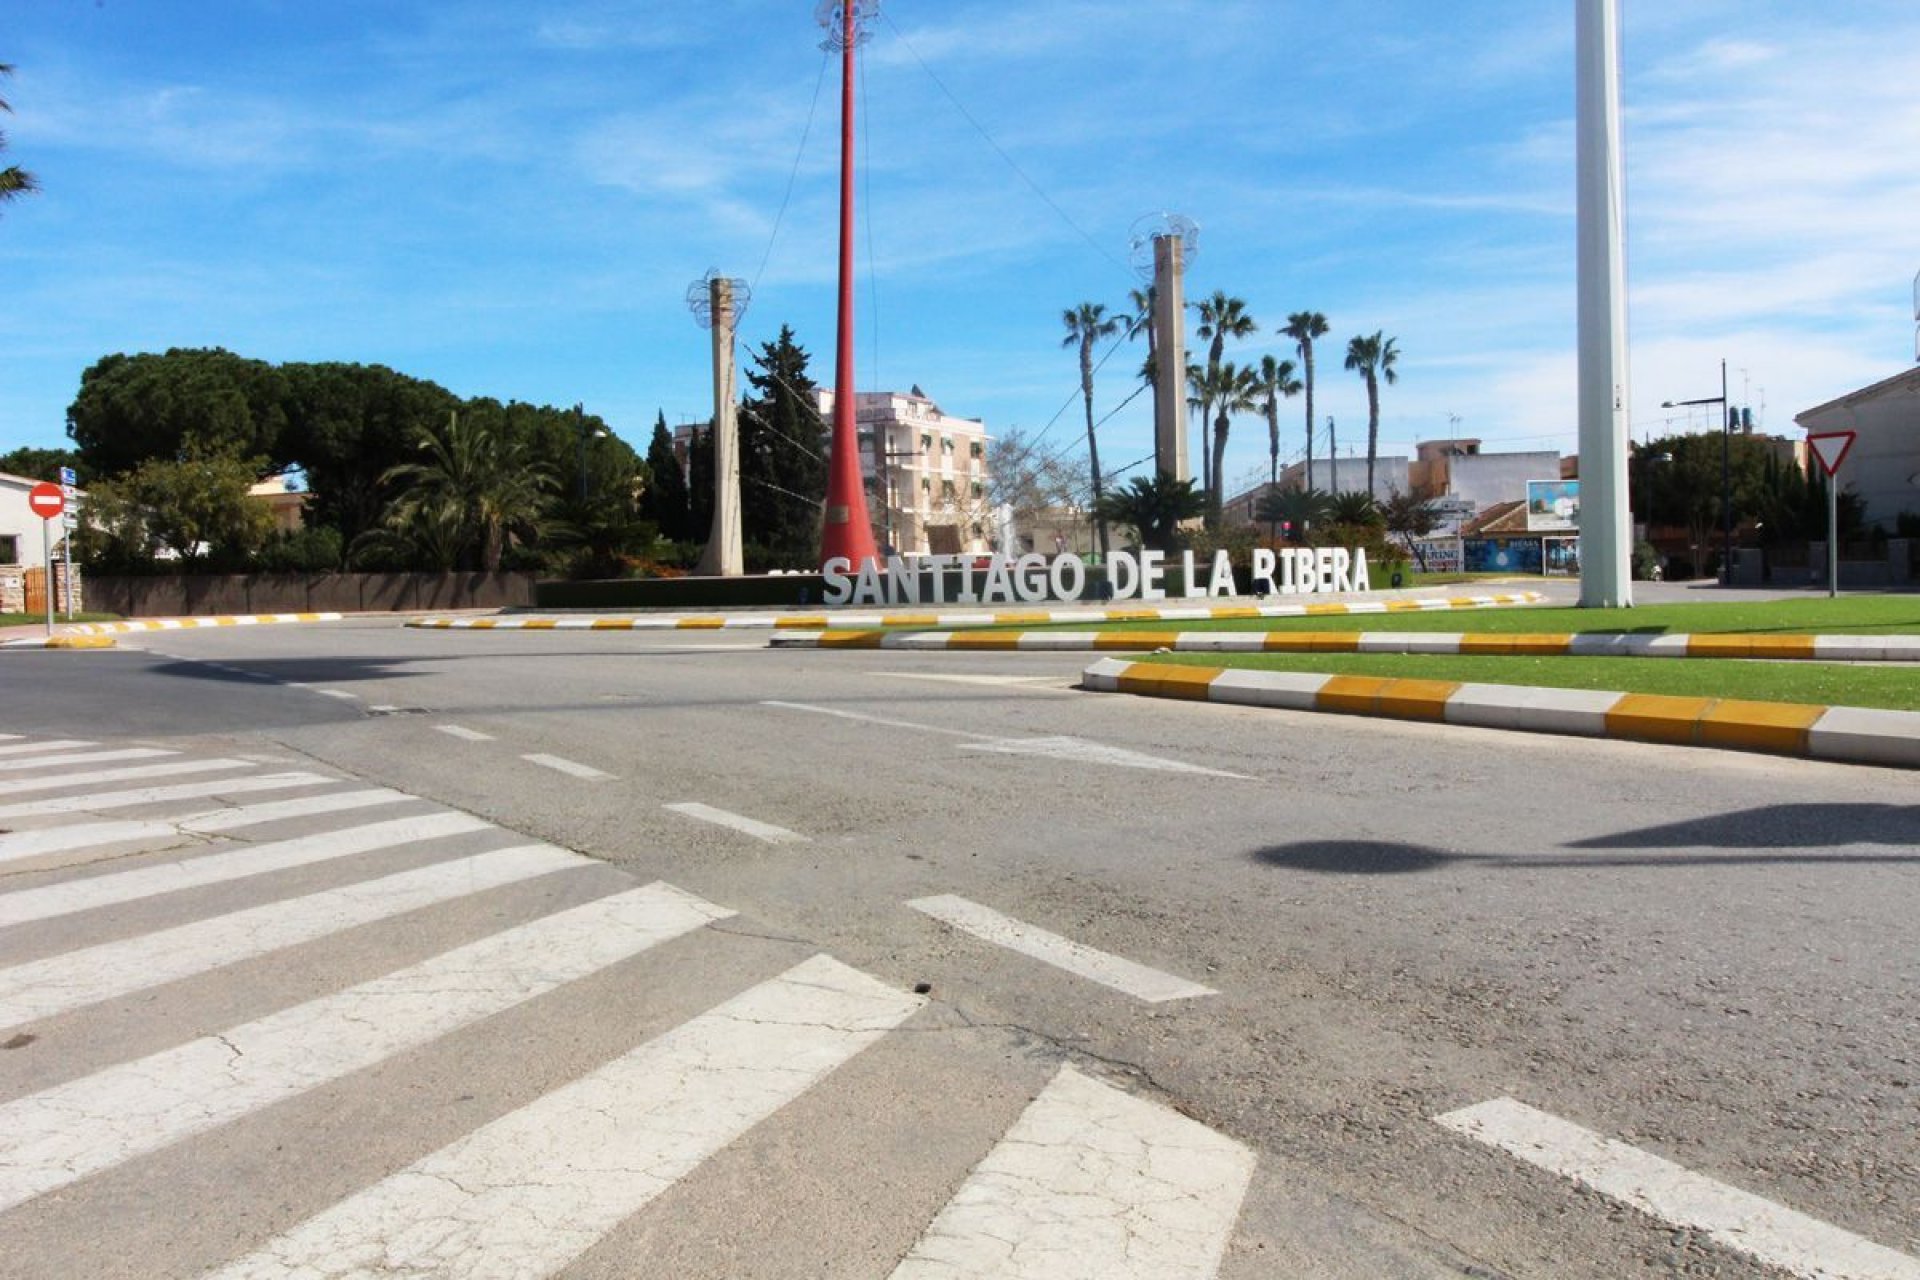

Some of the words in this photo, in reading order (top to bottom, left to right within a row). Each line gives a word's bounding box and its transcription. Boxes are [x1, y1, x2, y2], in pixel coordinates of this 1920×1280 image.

[823, 553, 1085, 604] SANTIAGO
[1106, 550, 1166, 600] DE
[1183, 548, 1237, 597] LA
[1253, 547, 1370, 595] RIBERA
